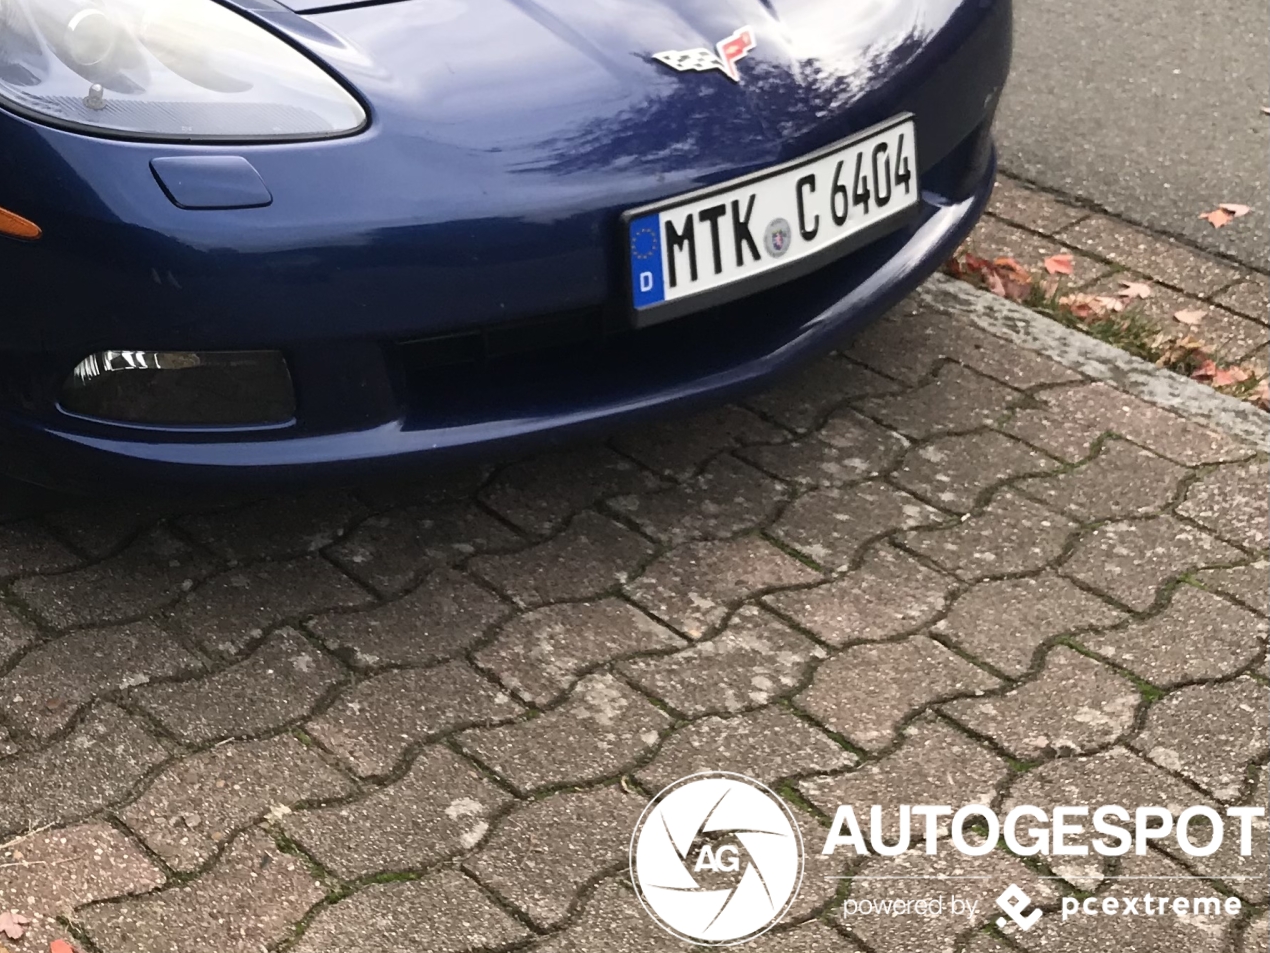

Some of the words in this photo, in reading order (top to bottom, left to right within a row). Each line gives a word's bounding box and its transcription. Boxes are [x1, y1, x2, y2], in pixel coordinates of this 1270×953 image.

[639, 271, 653, 292] D
[664, 193, 762, 288] MTK
[795, 173, 820, 242] C
[829, 132, 912, 227] 6404
